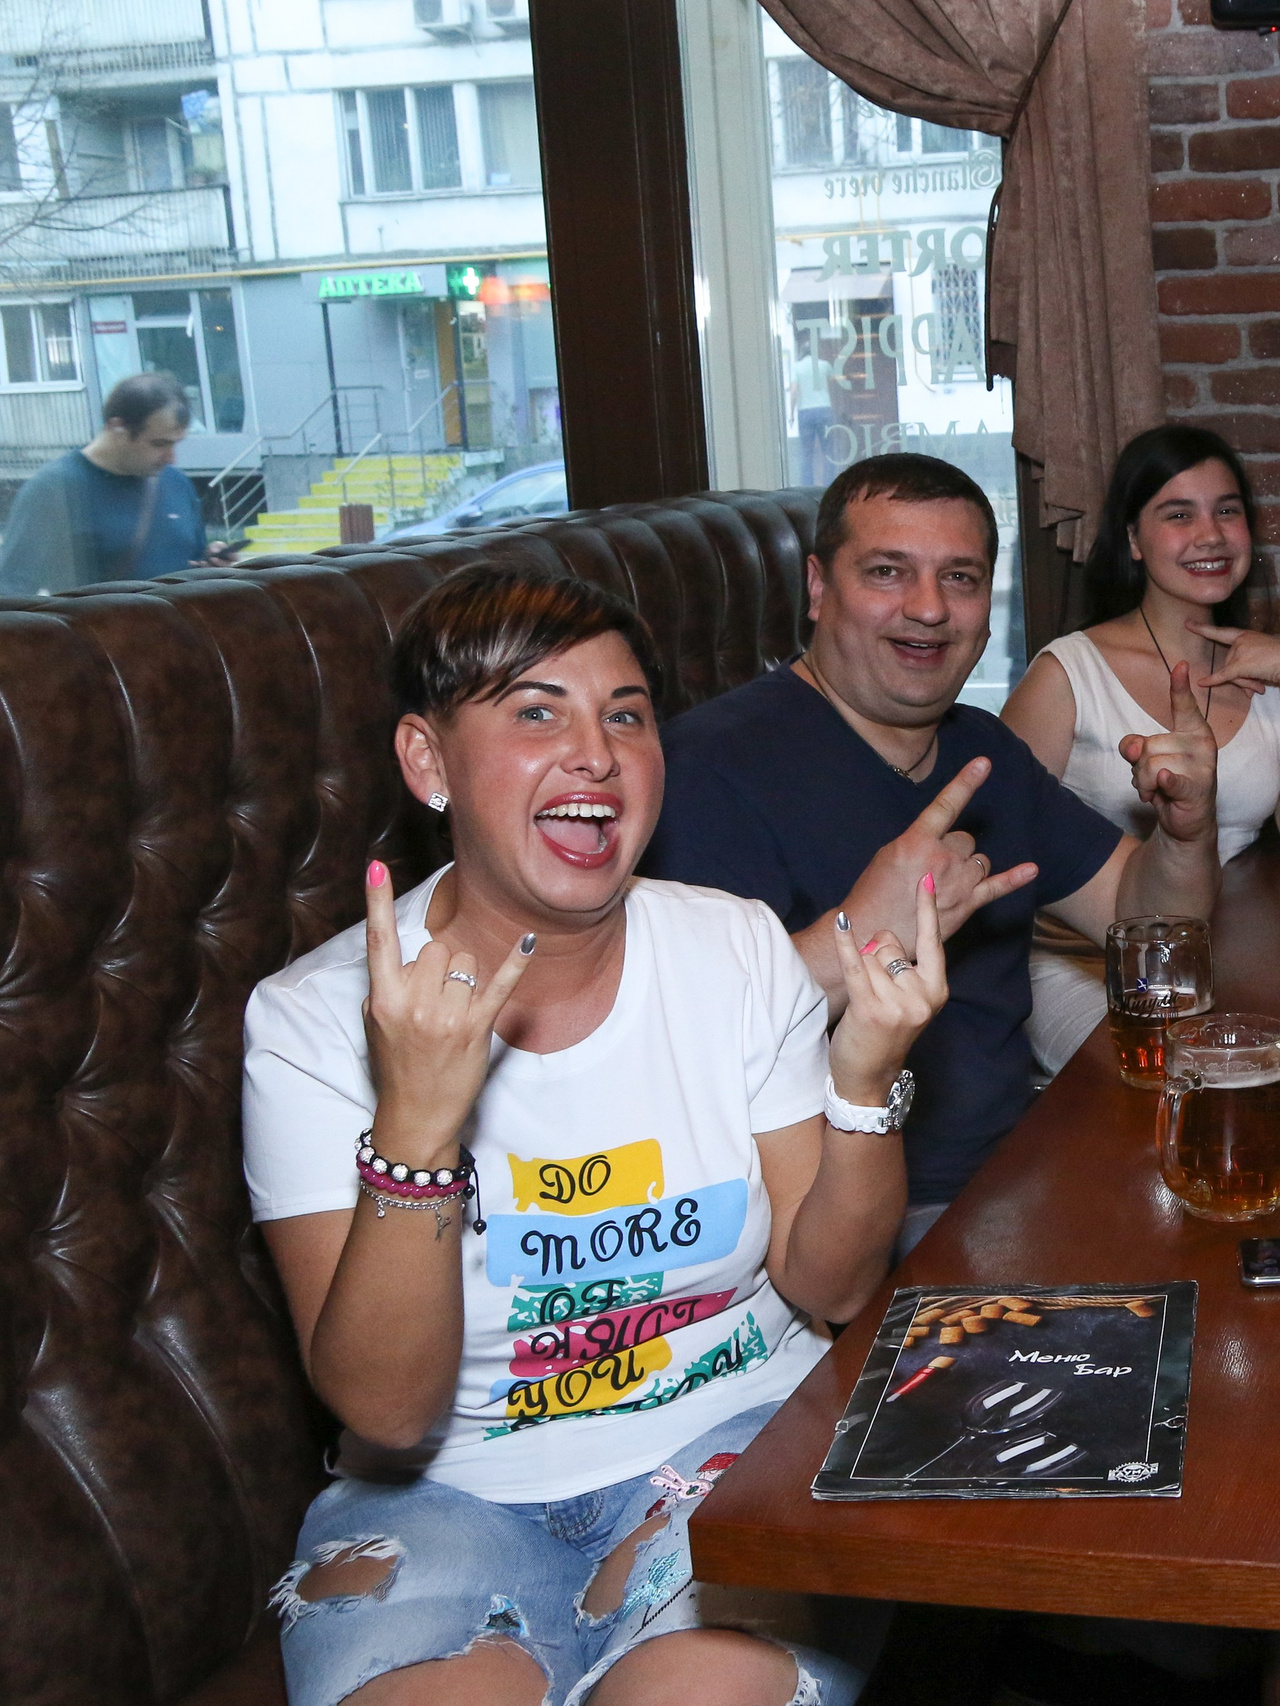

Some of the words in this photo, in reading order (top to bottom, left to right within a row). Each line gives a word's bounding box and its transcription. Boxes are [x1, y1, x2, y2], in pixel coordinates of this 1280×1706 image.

[318, 271, 424, 298] АПТЕКА
[538, 1154, 612, 1204] DO
[520, 1198, 701, 1277] MORE
[540, 1279, 626, 1325] OF
[1008, 1349, 1091, 1363] Меню
[1073, 1363, 1133, 1378] Бар
[507, 1350, 645, 1418] YOU
